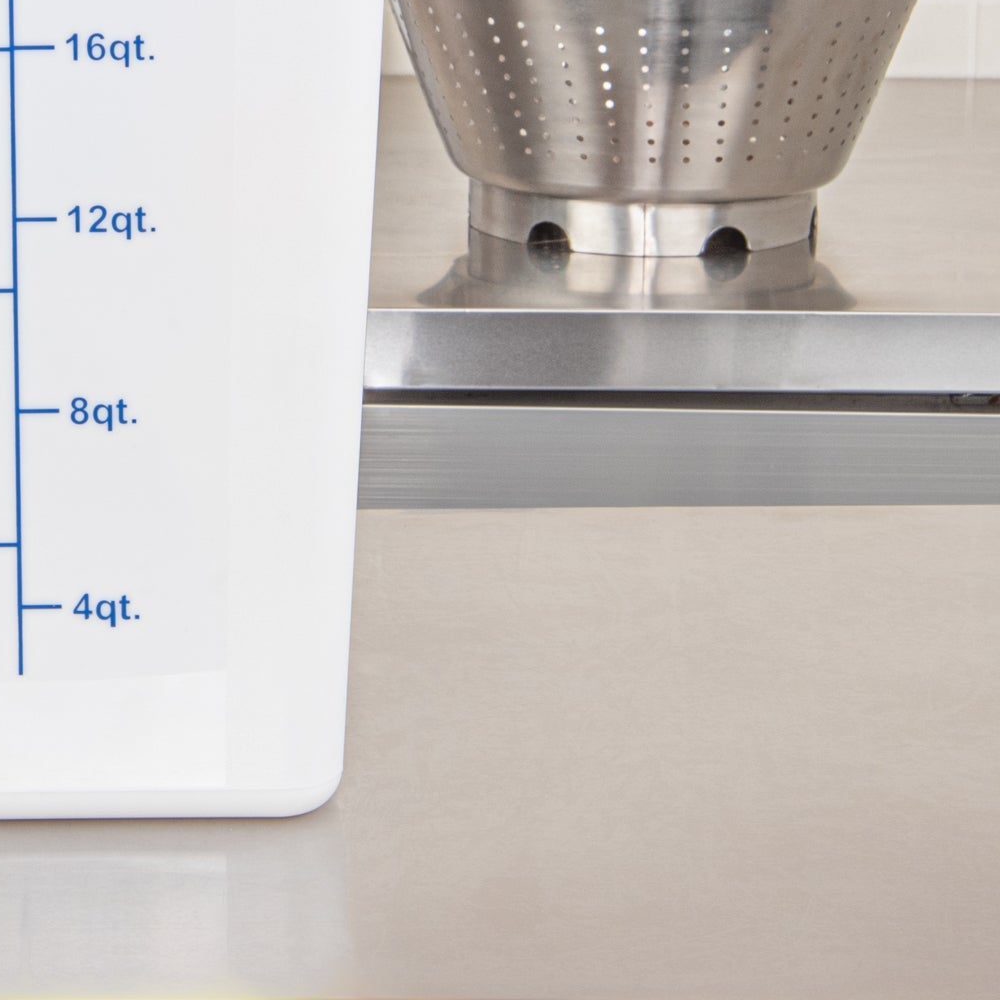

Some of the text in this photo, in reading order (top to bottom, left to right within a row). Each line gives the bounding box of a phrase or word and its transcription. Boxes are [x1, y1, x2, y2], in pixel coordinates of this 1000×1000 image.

[66, 32, 155, 67] 16qt.
[67, 204, 157, 240] 12qt.
[69, 396, 137, 431] 8qt.
[72, 593, 141, 627] 4qt.
